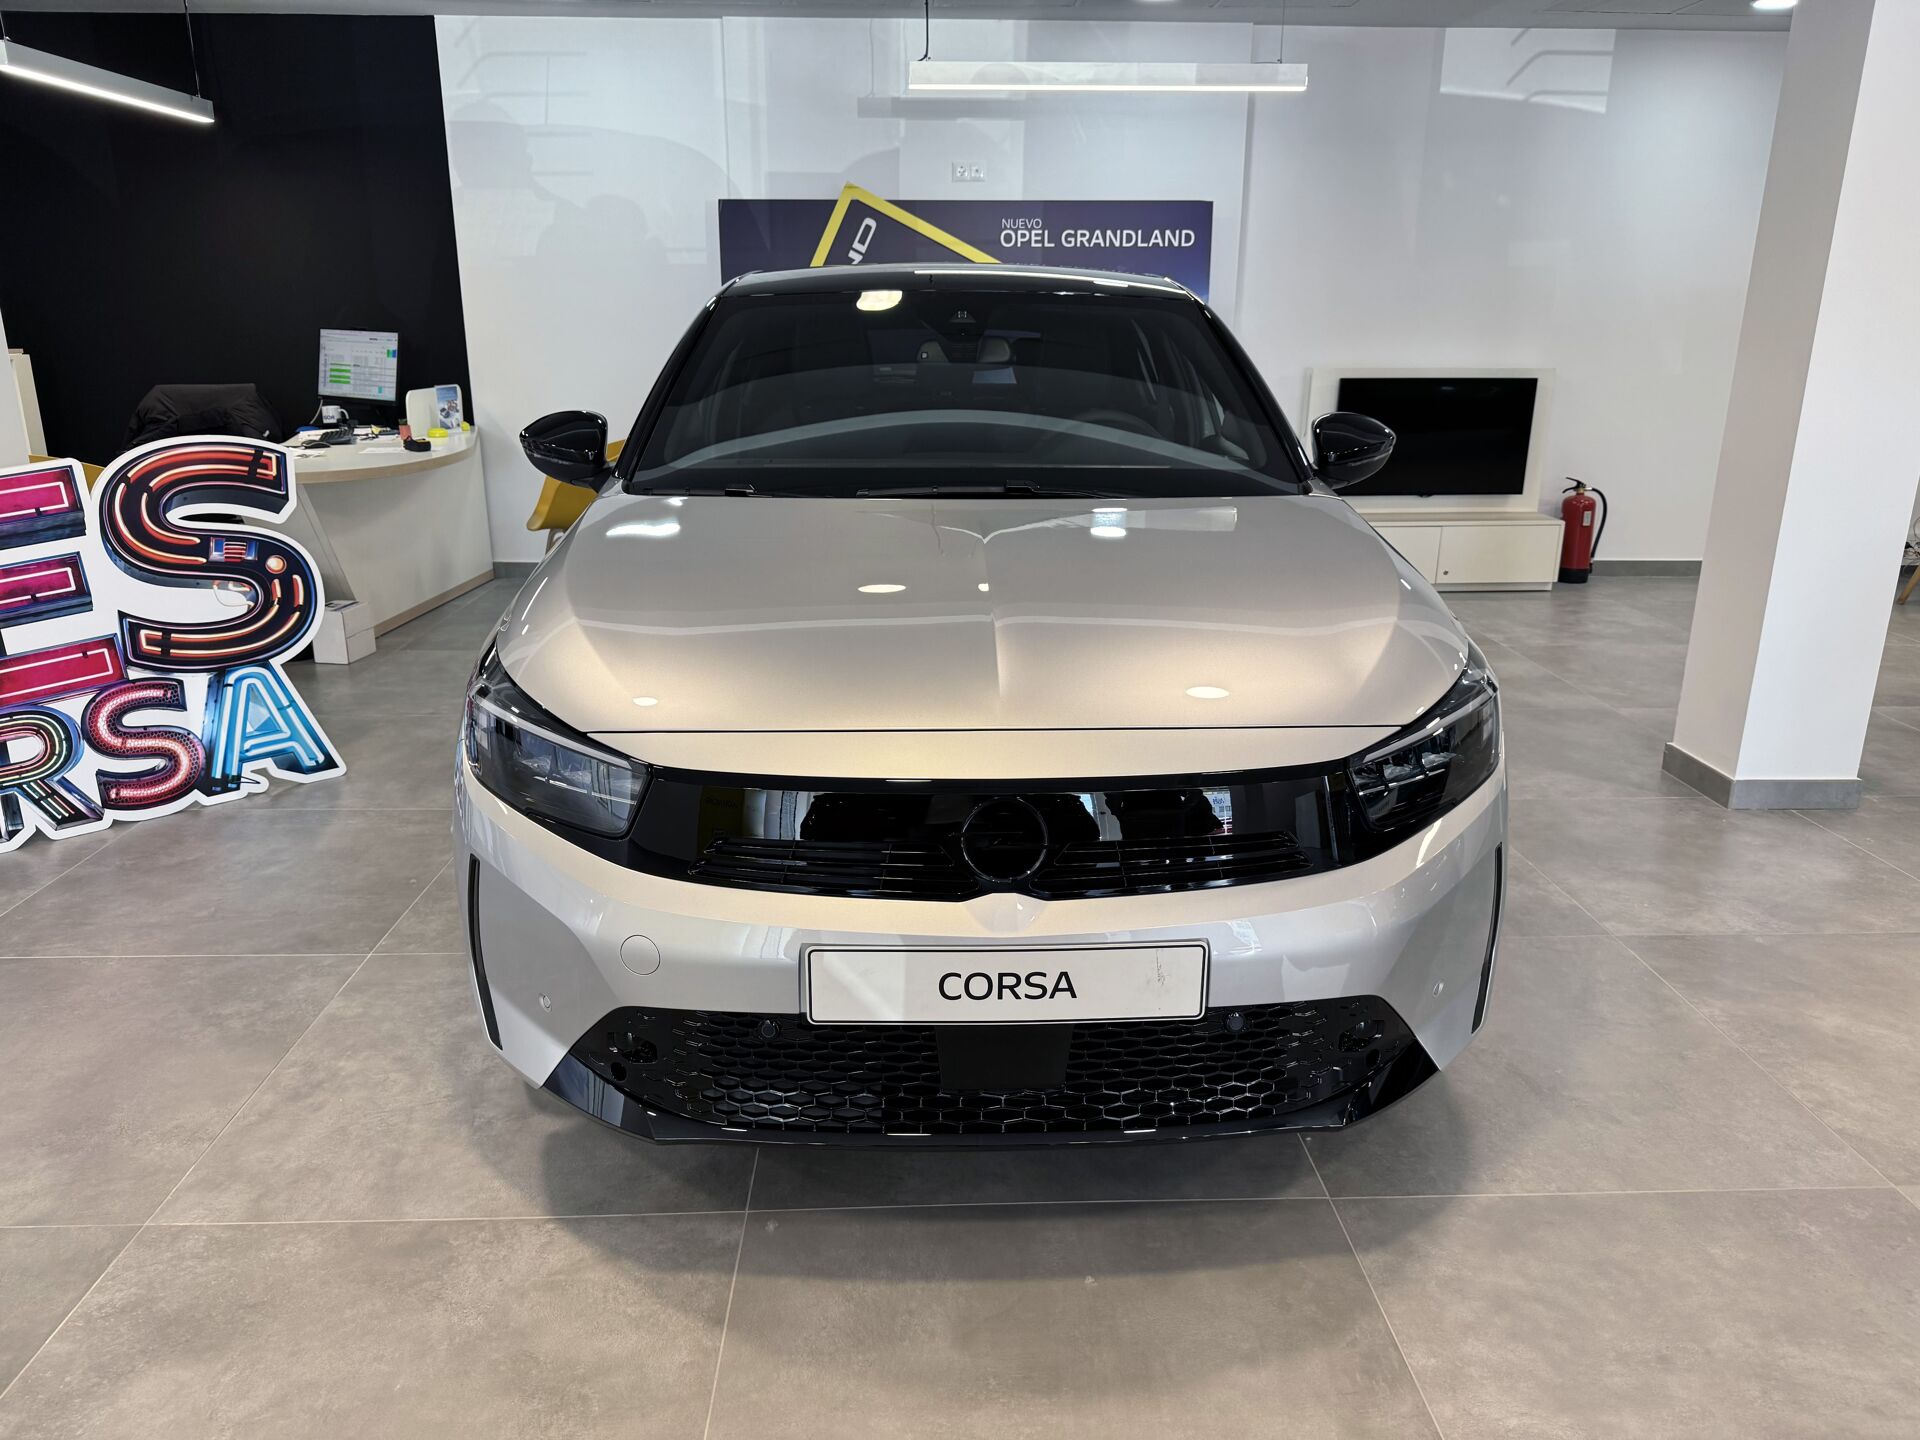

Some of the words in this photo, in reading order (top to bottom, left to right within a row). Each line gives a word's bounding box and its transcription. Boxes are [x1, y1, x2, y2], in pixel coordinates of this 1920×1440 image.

[1001, 218, 1042, 229] NUEVO
[1000, 229, 1055, 248] OPEL
[1061, 229, 1195, 248] GRANDLAND
[938, 971, 1078, 1001] CORSA
